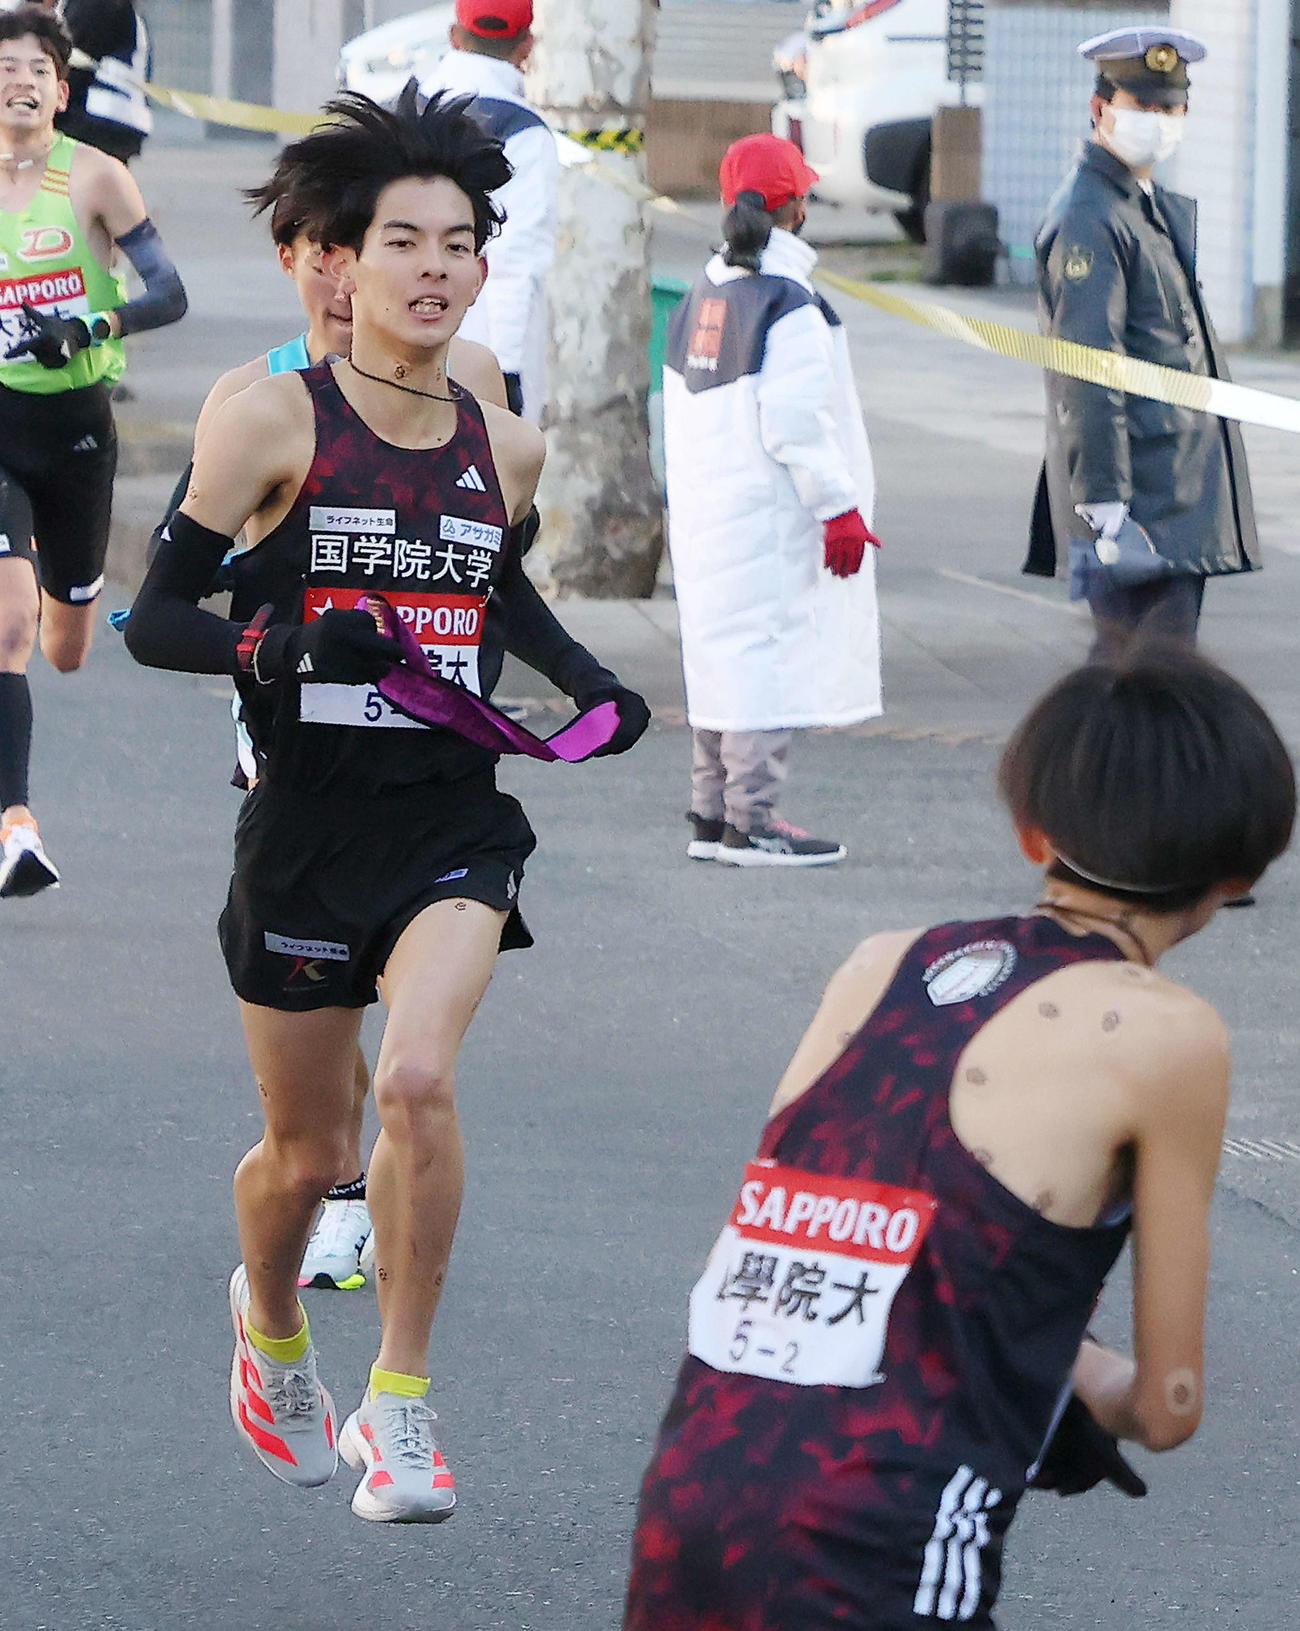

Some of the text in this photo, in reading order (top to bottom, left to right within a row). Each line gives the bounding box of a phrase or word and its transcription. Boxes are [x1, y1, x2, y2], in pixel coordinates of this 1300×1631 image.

[326, 515, 394, 527] ライフネット生命
[460, 523, 501, 545] アサガミ
[310, 533, 493, 589] 国学院大学
[396, 605, 479, 636] PPORO
[364, 691, 401, 722] 5-
[736, 1180, 920, 1254] SAPPORO
[729, 1319, 799, 1374] 5-2
